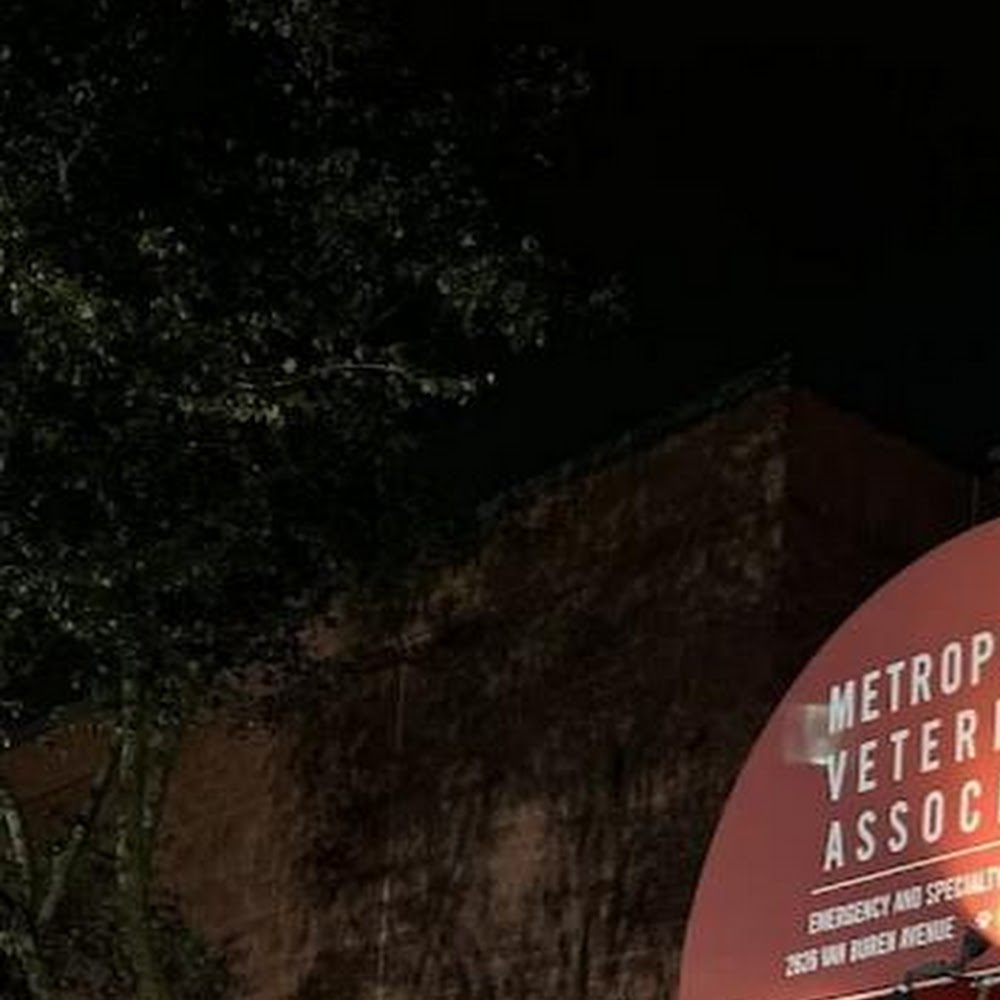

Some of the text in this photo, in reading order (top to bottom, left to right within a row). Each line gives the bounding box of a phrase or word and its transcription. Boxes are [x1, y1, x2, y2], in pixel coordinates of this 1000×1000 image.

[808, 893, 892, 934] EMERGENCY
[892, 885, 923, 914] AND
[899, 915, 957, 949] AVENUE
